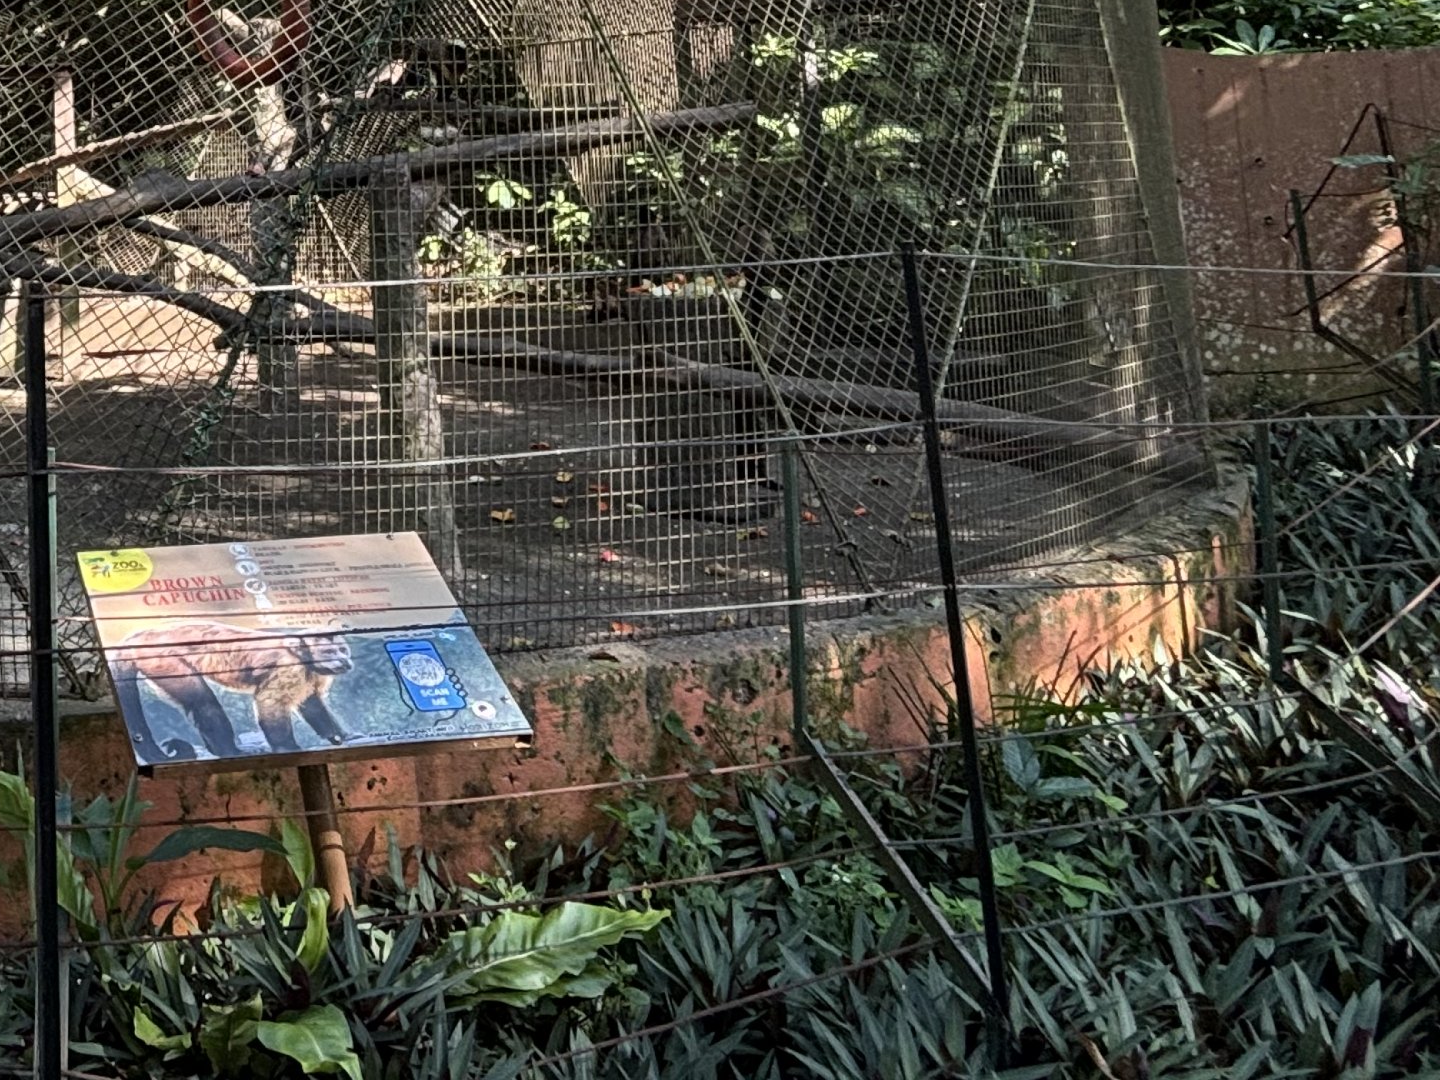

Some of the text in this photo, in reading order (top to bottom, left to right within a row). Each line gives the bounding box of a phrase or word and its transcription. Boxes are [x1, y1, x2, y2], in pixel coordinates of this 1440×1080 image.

[150, 575, 223, 591] BROWN
[143, 588, 246, 606] CAPUCHIN
[419, 688, 450, 698] SCAN
[431, 697, 449, 706] ME
